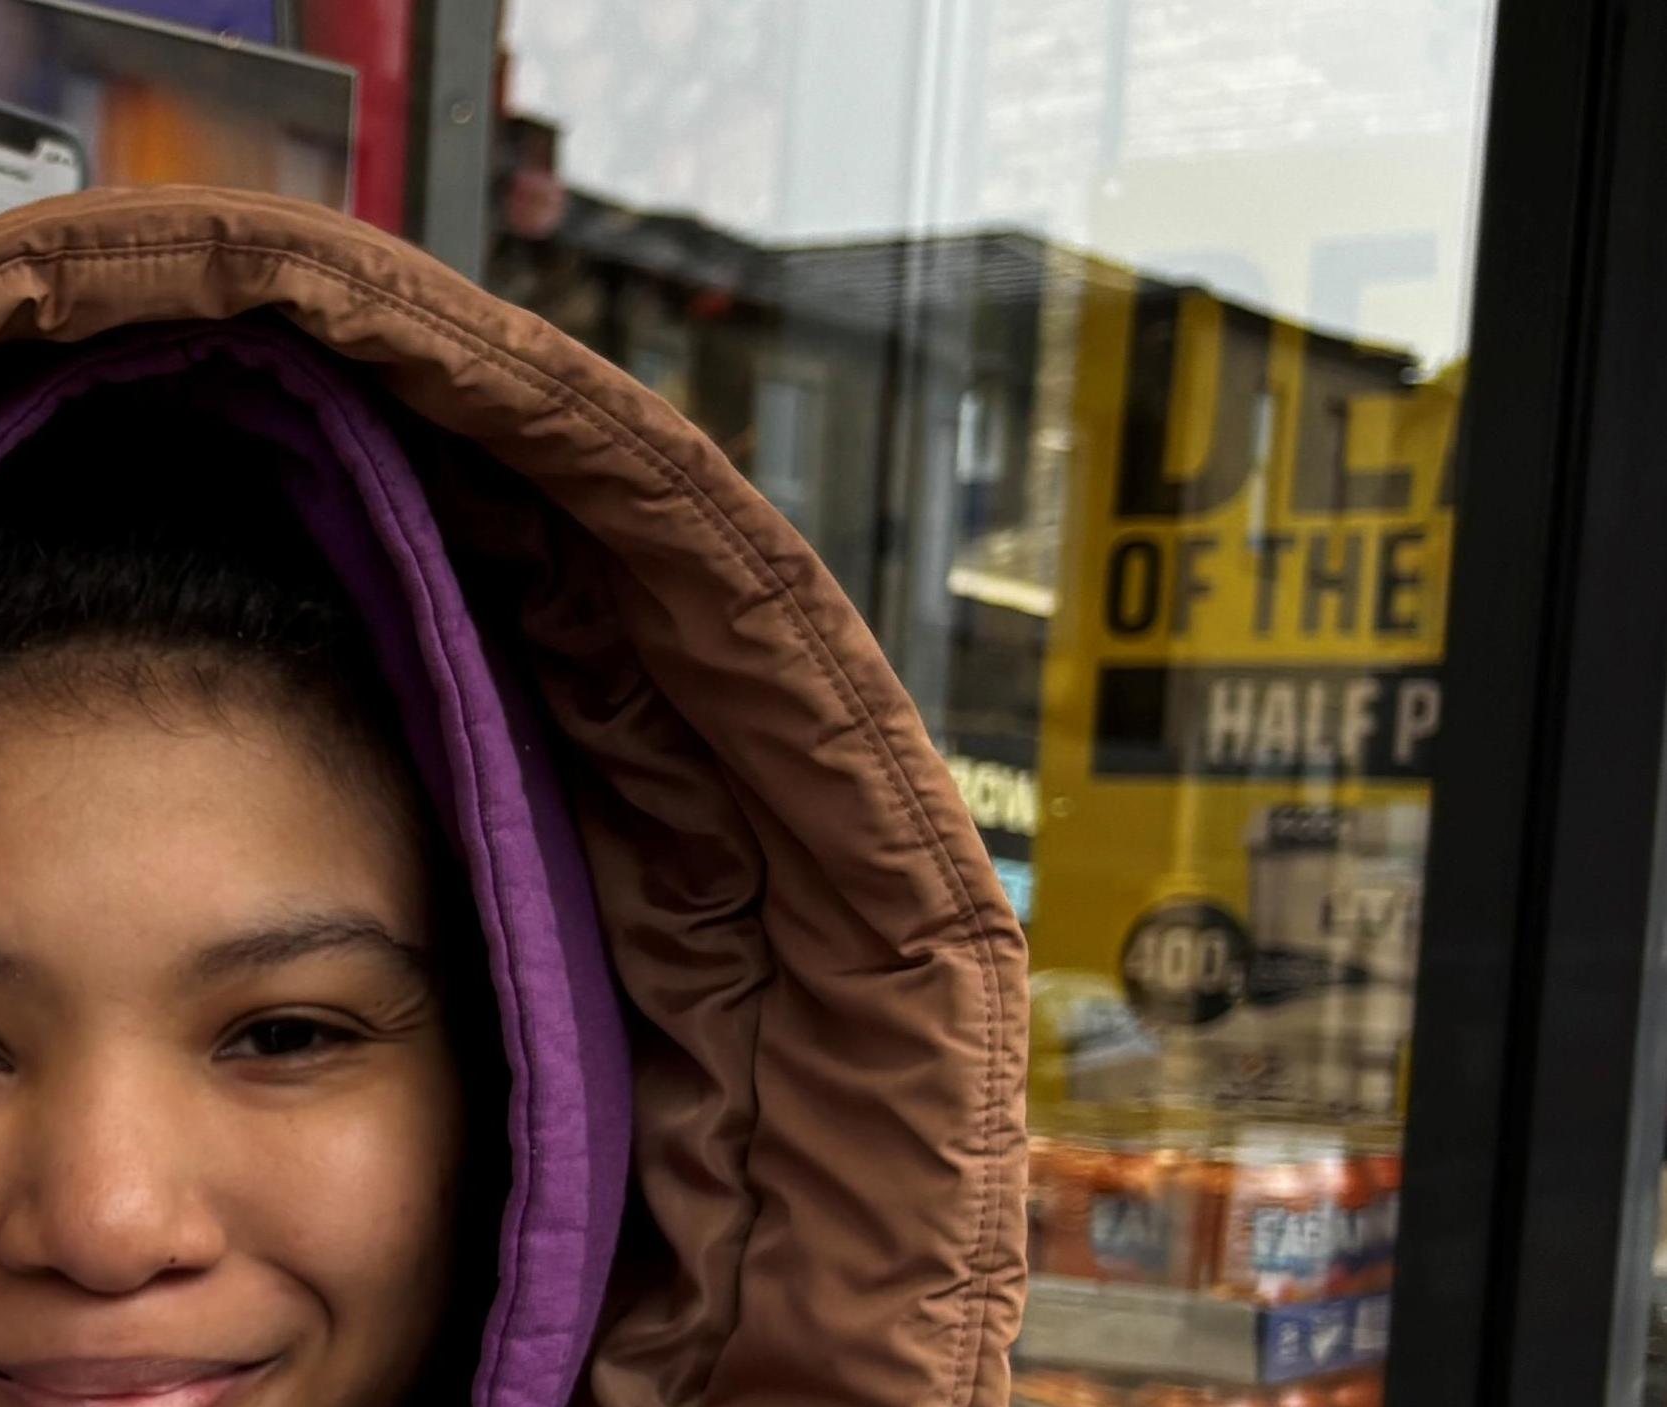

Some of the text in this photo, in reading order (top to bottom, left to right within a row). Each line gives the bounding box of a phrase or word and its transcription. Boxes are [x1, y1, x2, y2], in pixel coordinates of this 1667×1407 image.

[1104, 530, 1424, 643] OF THE
[1205, 677, 1378, 768] HALF
